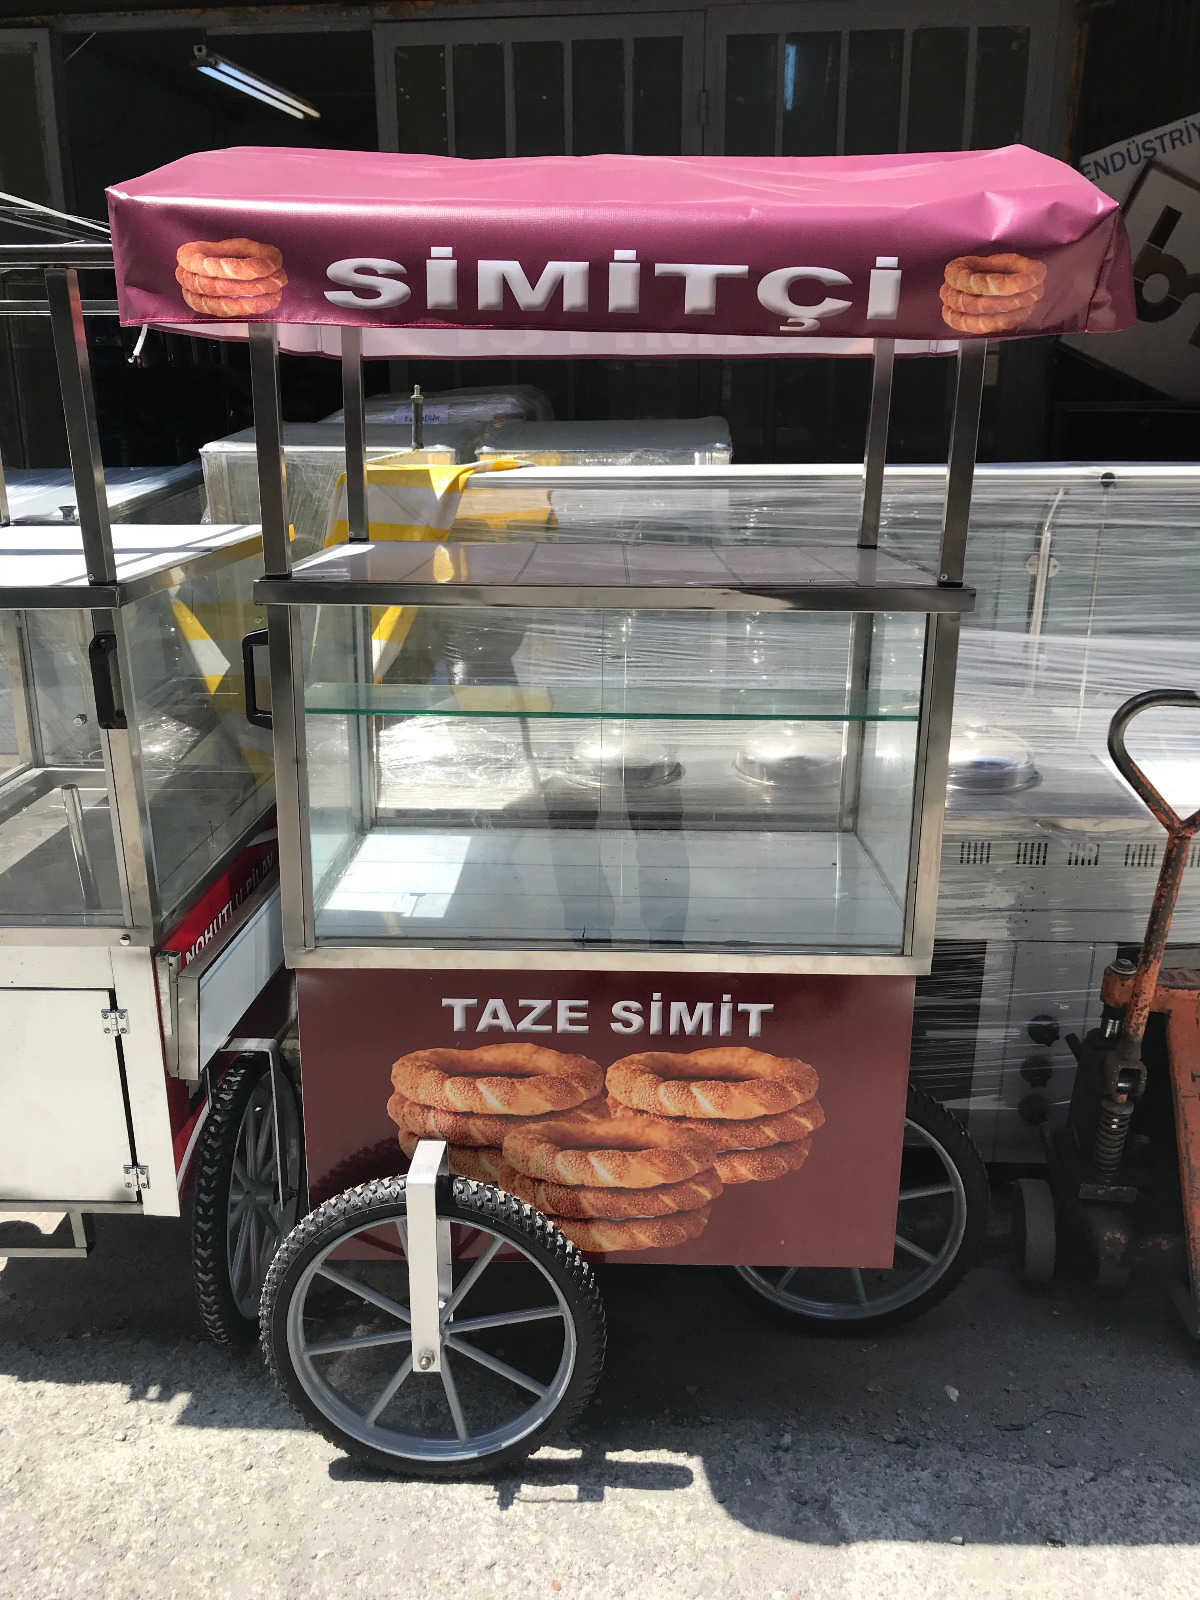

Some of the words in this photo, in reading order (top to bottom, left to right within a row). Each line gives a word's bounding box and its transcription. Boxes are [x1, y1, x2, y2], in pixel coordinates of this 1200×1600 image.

[323, 246, 902, 331] SİMİTÇİ
[441, 997, 590, 1034] TAZE
[609, 992, 775, 1038] SİMİT
